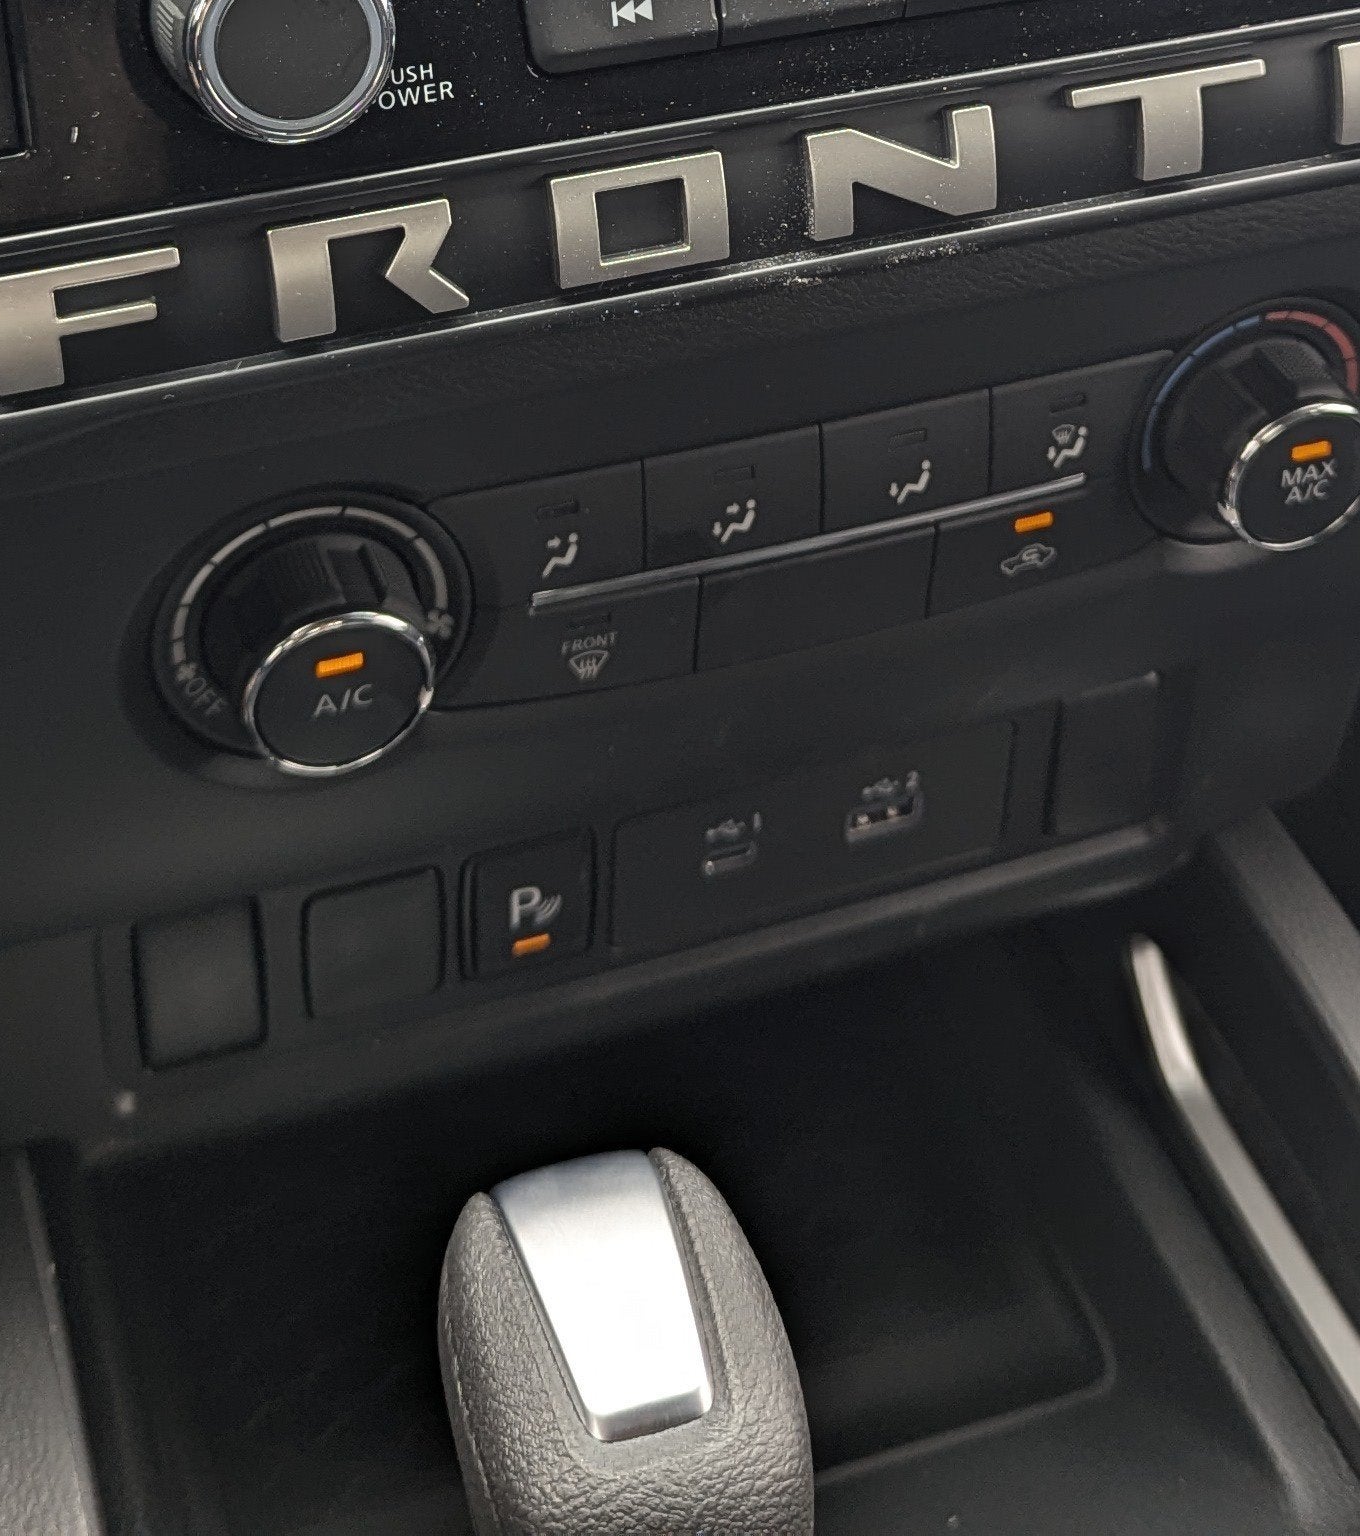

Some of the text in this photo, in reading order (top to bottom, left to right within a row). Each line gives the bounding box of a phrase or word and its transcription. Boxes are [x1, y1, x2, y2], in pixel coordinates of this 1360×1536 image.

[390, 63, 434, 85] USH
[378, 80, 455, 110] OWER
[1280, 460, 1337, 488] MAX
[1284, 478, 1329, 505] A/C
[560, 630, 618, 655] FRONT
[313, 683, 374, 719] A/C
[509, 887, 541, 929] P
